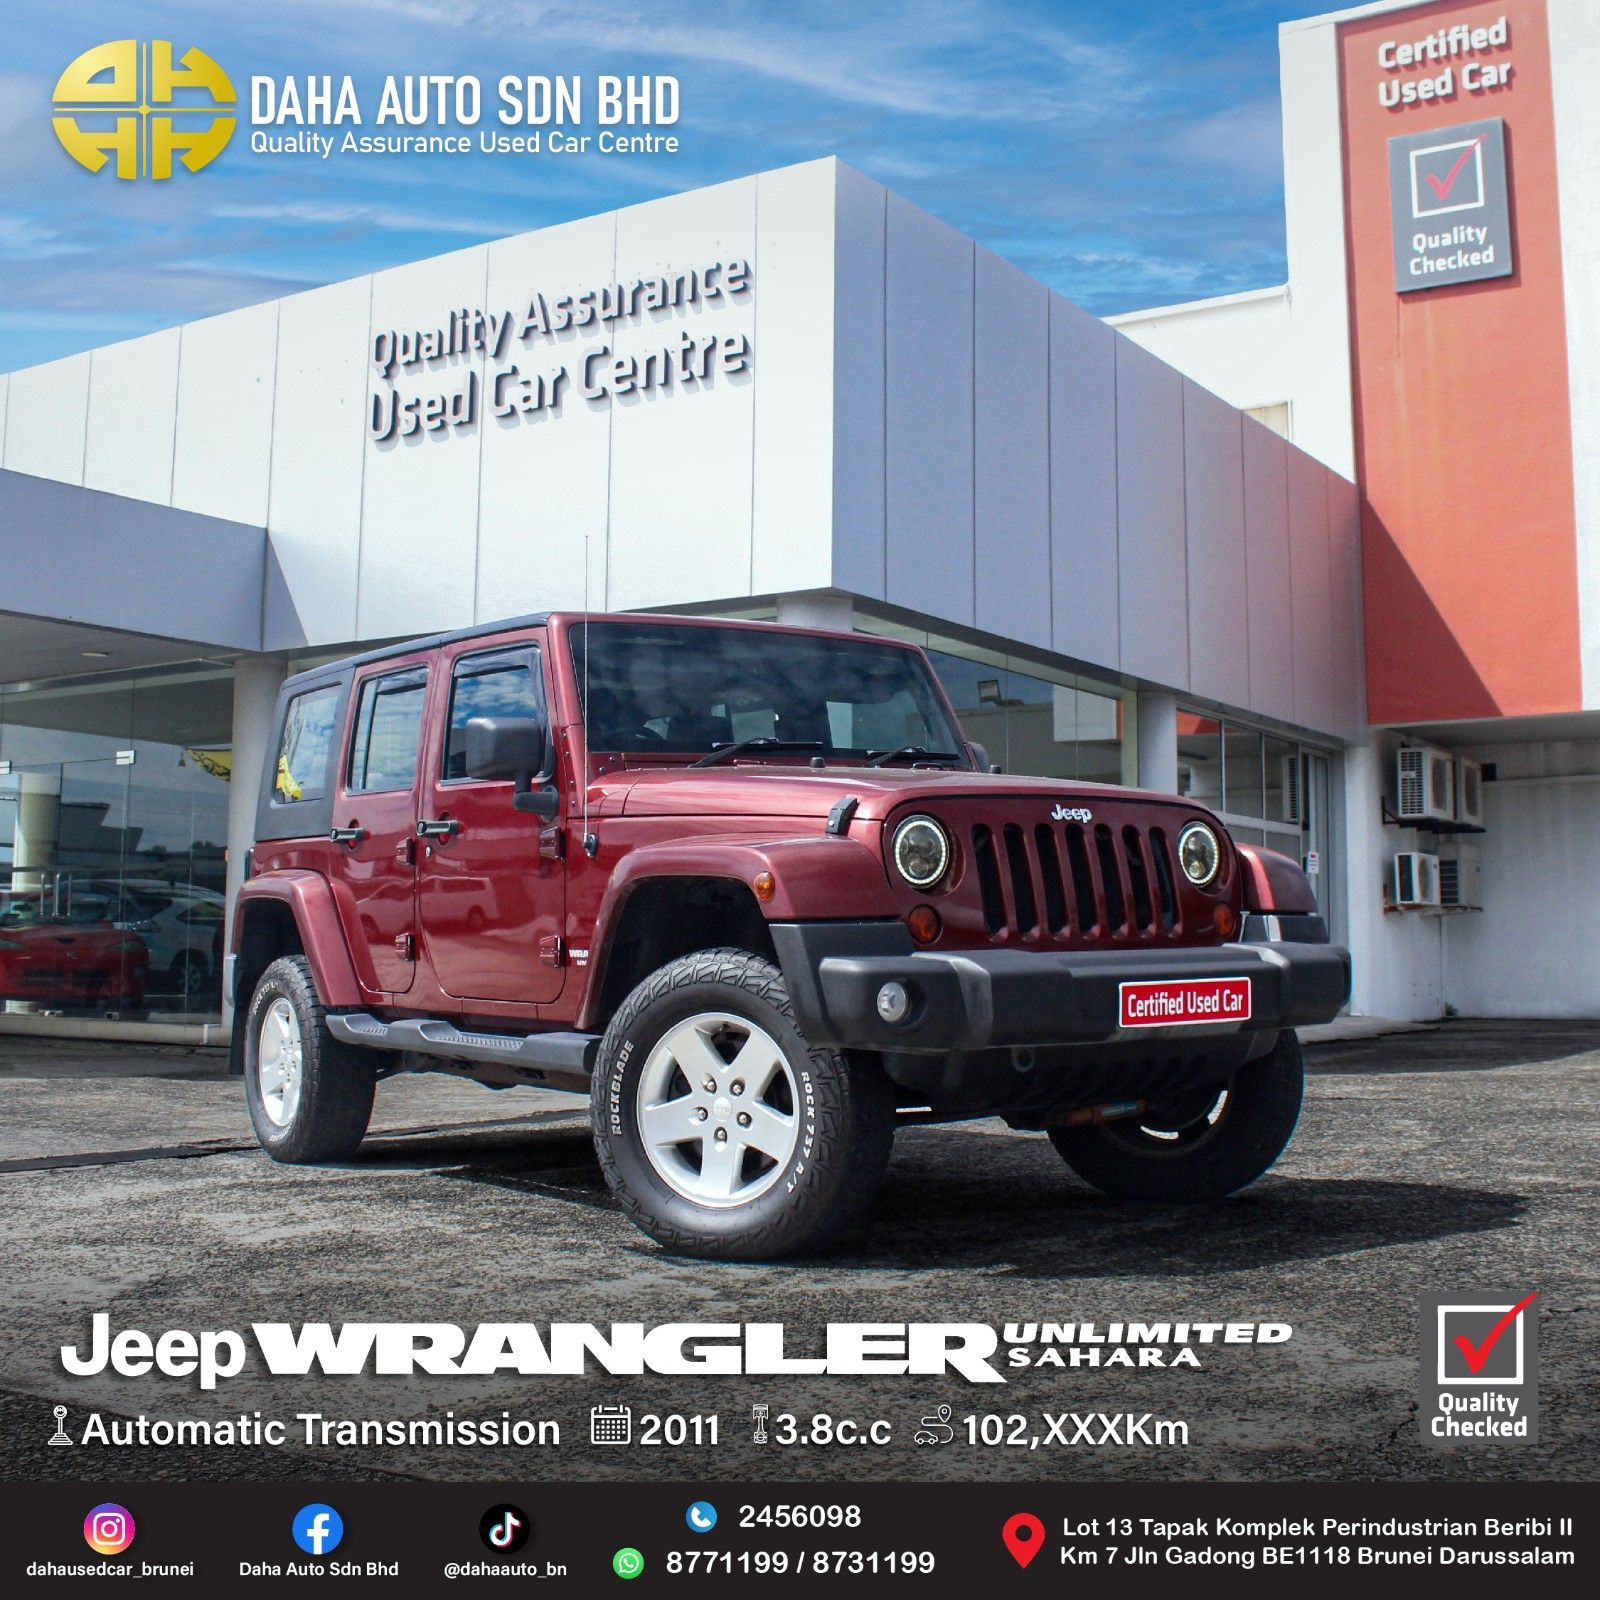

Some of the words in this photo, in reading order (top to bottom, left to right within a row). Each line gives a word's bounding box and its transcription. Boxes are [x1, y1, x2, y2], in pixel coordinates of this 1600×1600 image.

[1378, 15, 1507, 69] Certified
[1378, 66, 1453, 107] Used
[1462, 61, 1512, 90] Car
[1409, 244, 1495, 275] Checked
[1412, 225, 1488, 254] Quality
[372, 306, 512, 379] Quality
[518, 258, 753, 339] Assurance
[368, 370, 479, 442] Used
[490, 364, 569, 417] Car
[579, 330, 753, 400] Centre
[1051, 803, 1092, 824] Jeep
[1127, 991, 1184, 1018] Certified
[1187, 989, 1219, 1014] Used
[1223, 989, 1243, 1012] Car
[610, 1040, 634, 1135] ROCKBLADE
[801, 1071, 815, 1120] ROCK
[786, 1161, 804, 1194] A/T
